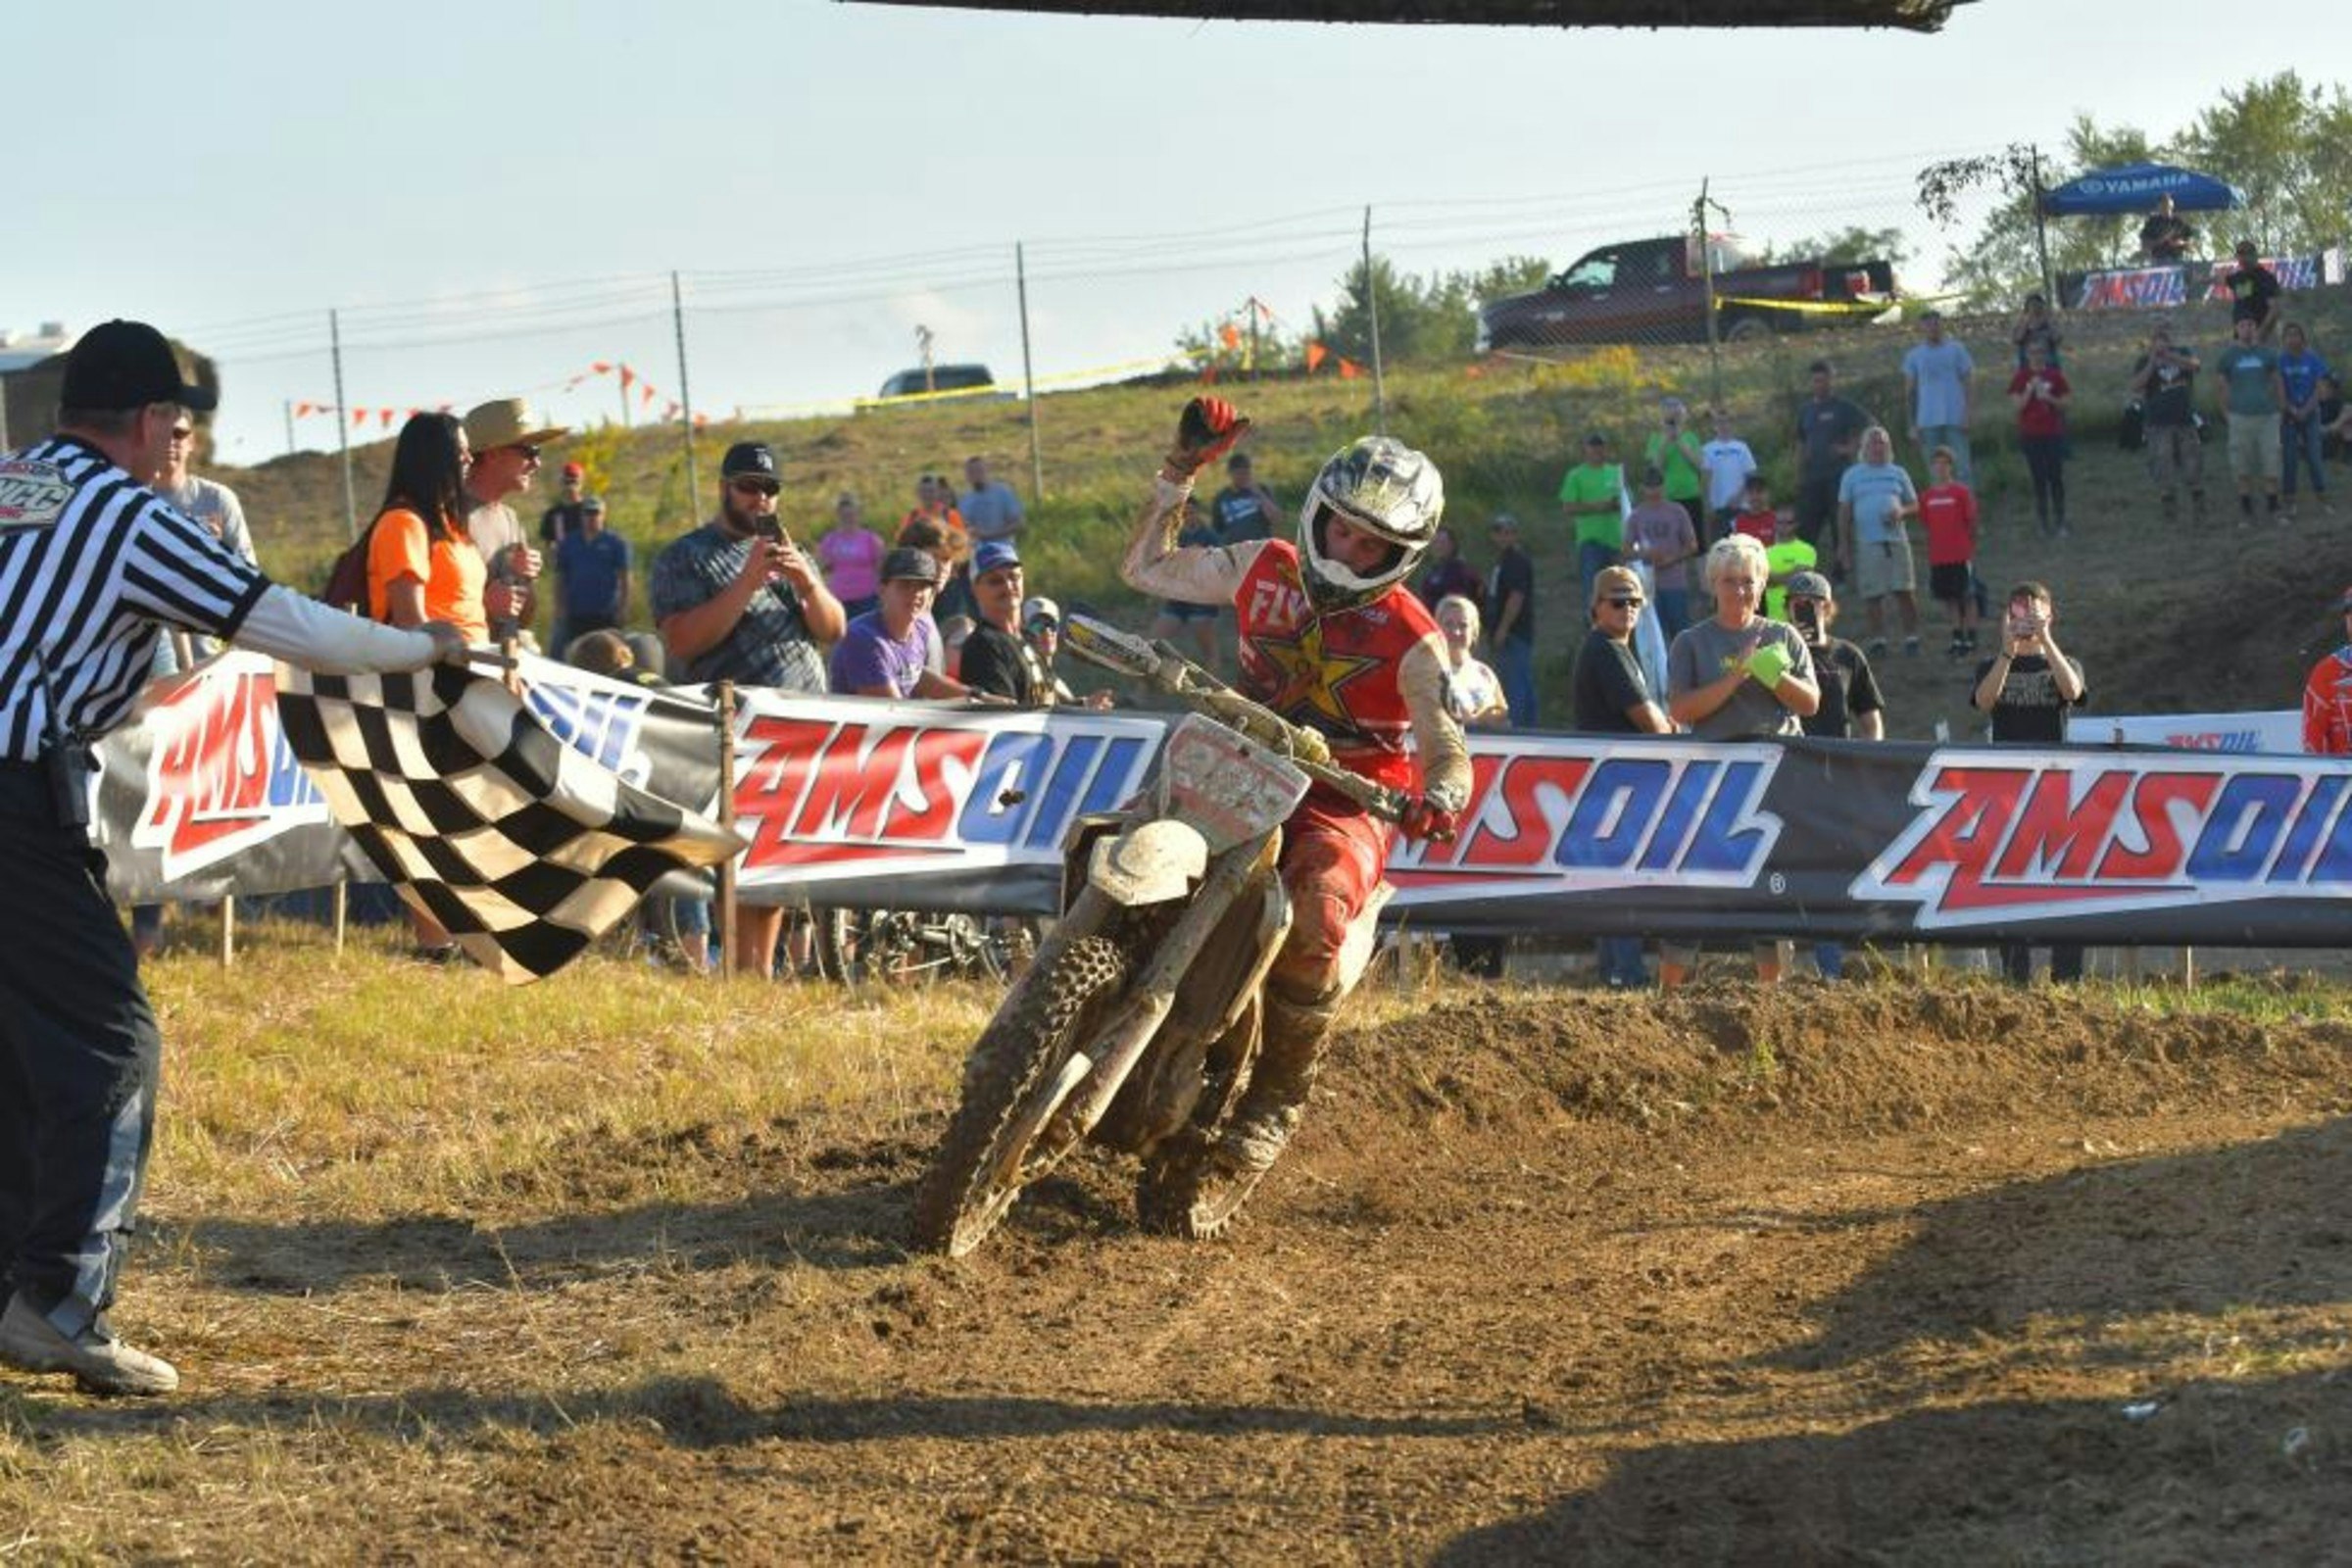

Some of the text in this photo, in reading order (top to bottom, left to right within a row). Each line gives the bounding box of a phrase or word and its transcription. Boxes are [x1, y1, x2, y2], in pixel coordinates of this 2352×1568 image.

[2106, 173, 2190, 193] YAMAHA
[2080, 268, 2186, 308] AMSOIL
[151, 672, 327, 855] AMSO
[1385, 755, 1766, 887] SOIL
